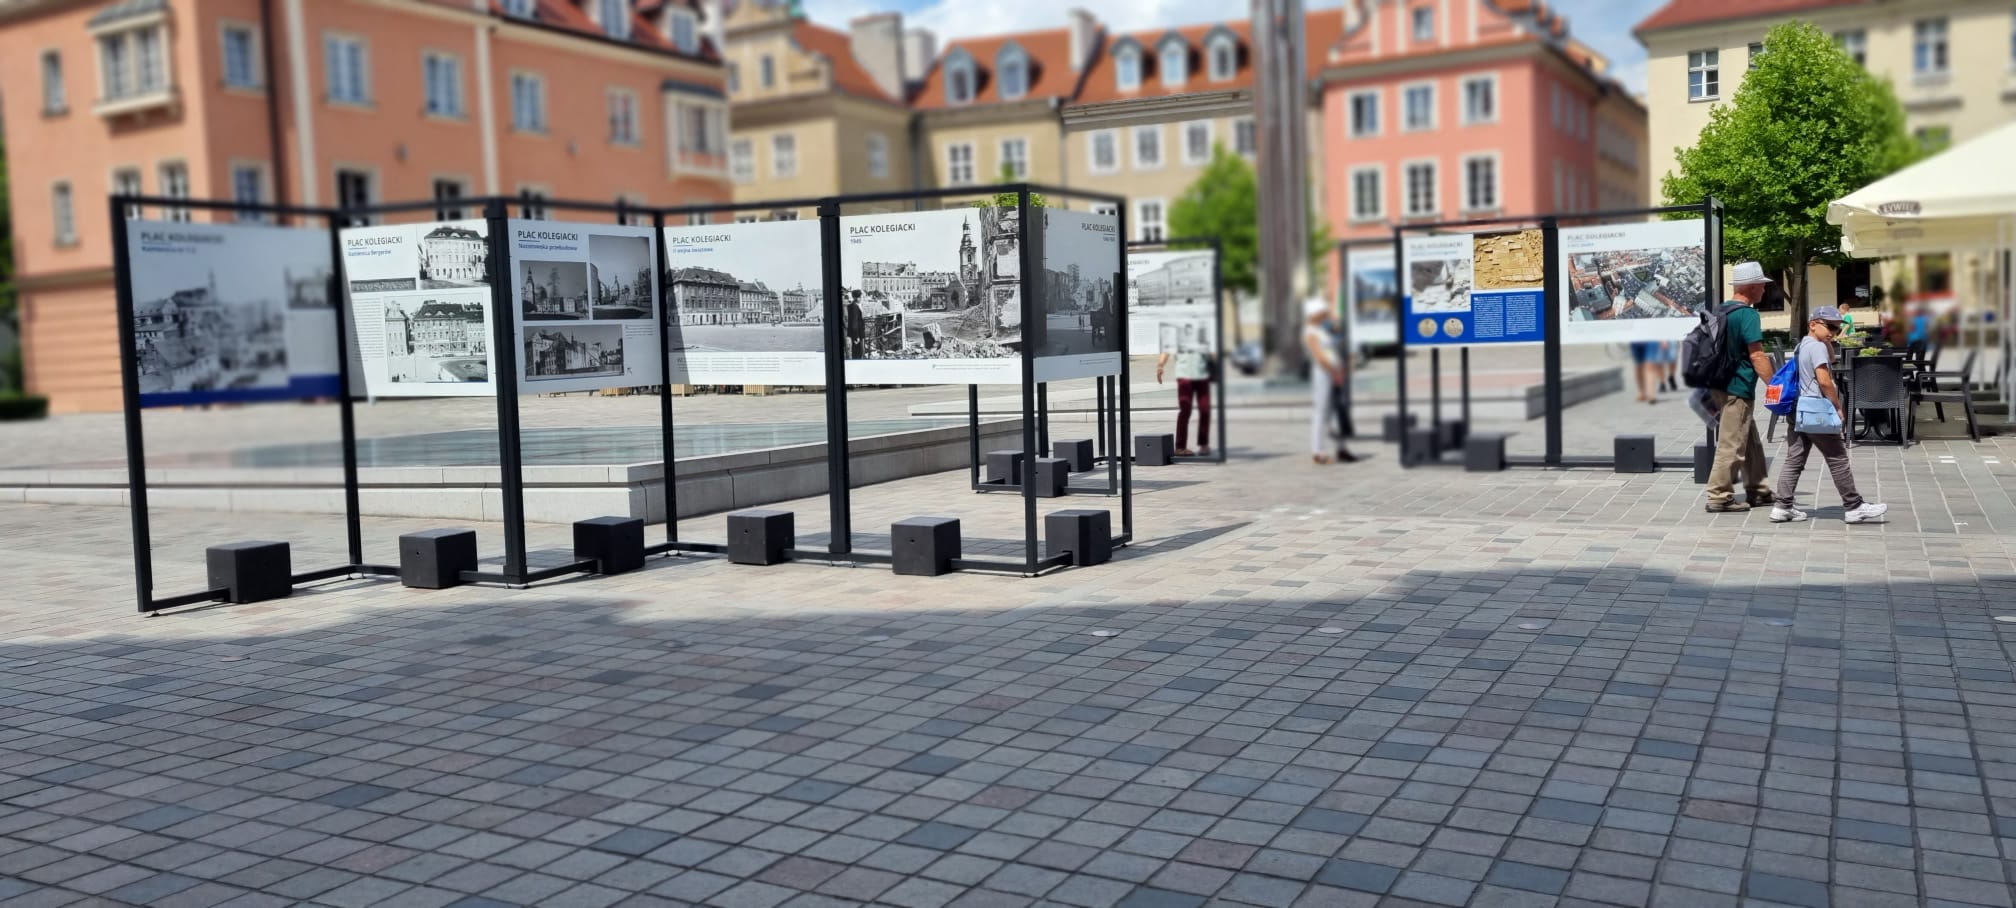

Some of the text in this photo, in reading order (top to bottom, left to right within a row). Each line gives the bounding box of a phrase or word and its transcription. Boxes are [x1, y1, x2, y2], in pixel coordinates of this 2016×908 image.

[850, 223, 916, 234] PLAC KOLEGIACKI
[1081, 223, 1092, 231] PLAC
[518, 230, 578, 241] PLAC KOLEGIACKI
[672, 234, 731, 244] PLAC KOLEGIACKI
[348, 236, 403, 247] PLAC KOLEGIACKI
